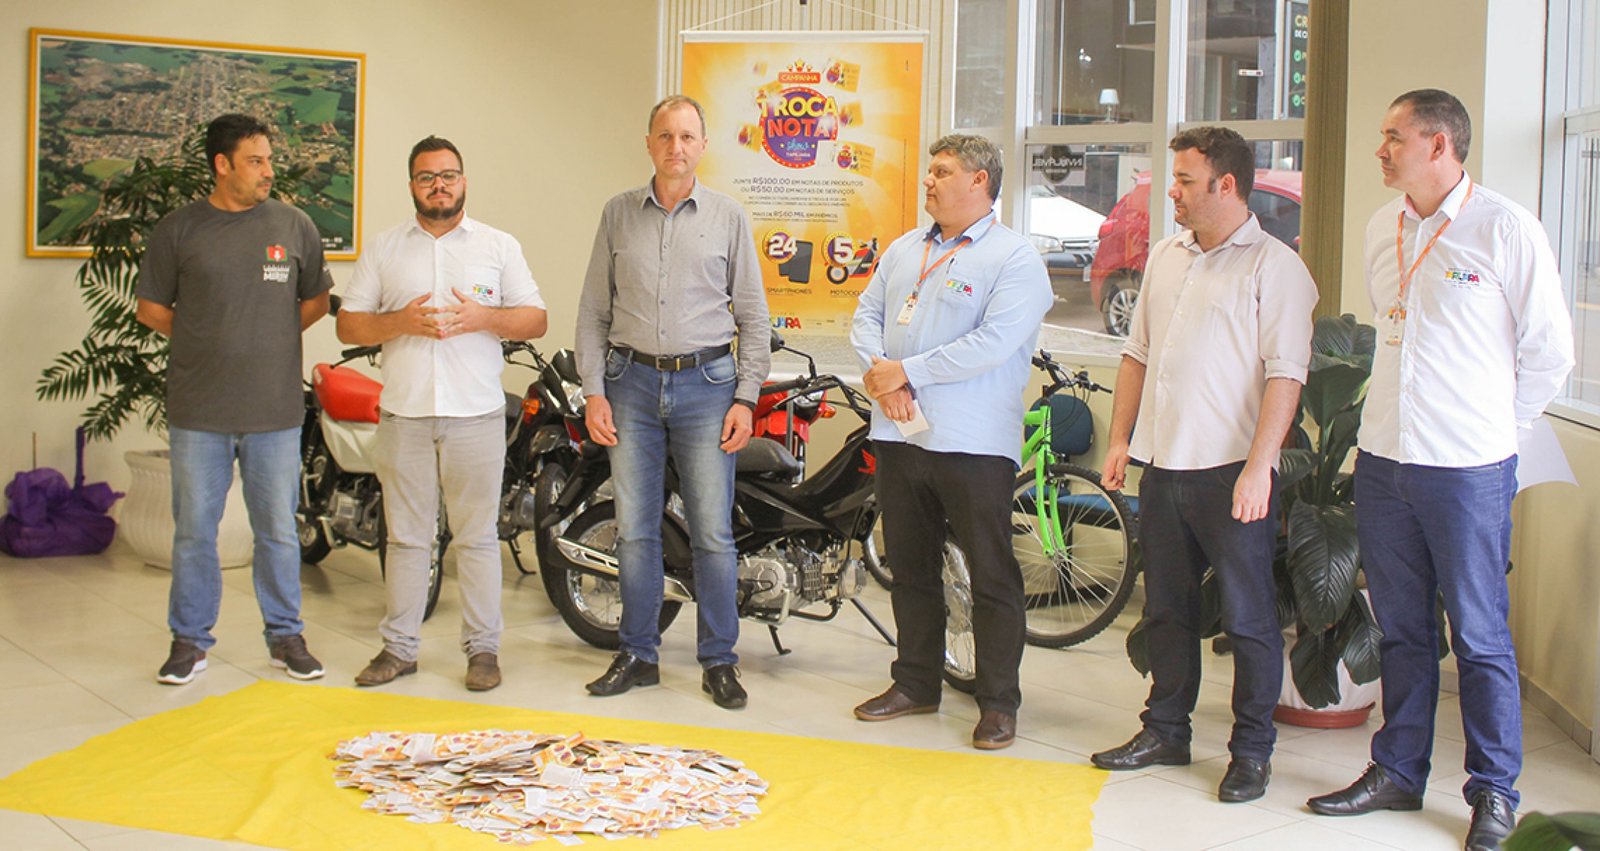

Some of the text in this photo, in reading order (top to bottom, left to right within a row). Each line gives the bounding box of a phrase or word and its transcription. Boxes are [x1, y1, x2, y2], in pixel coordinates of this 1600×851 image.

[781, 73, 818, 81] CAMPANHA
[757, 96, 837, 118] TROCA
[767, 117, 830, 138] NOTA
[825, 188, 855, 196] SERVIÇOS
[768, 235, 798, 256] 24
[833, 236, 853, 264] 5
[766, 287, 812, 295] SMARTPHONES
[772, 316, 801, 329] JARA
